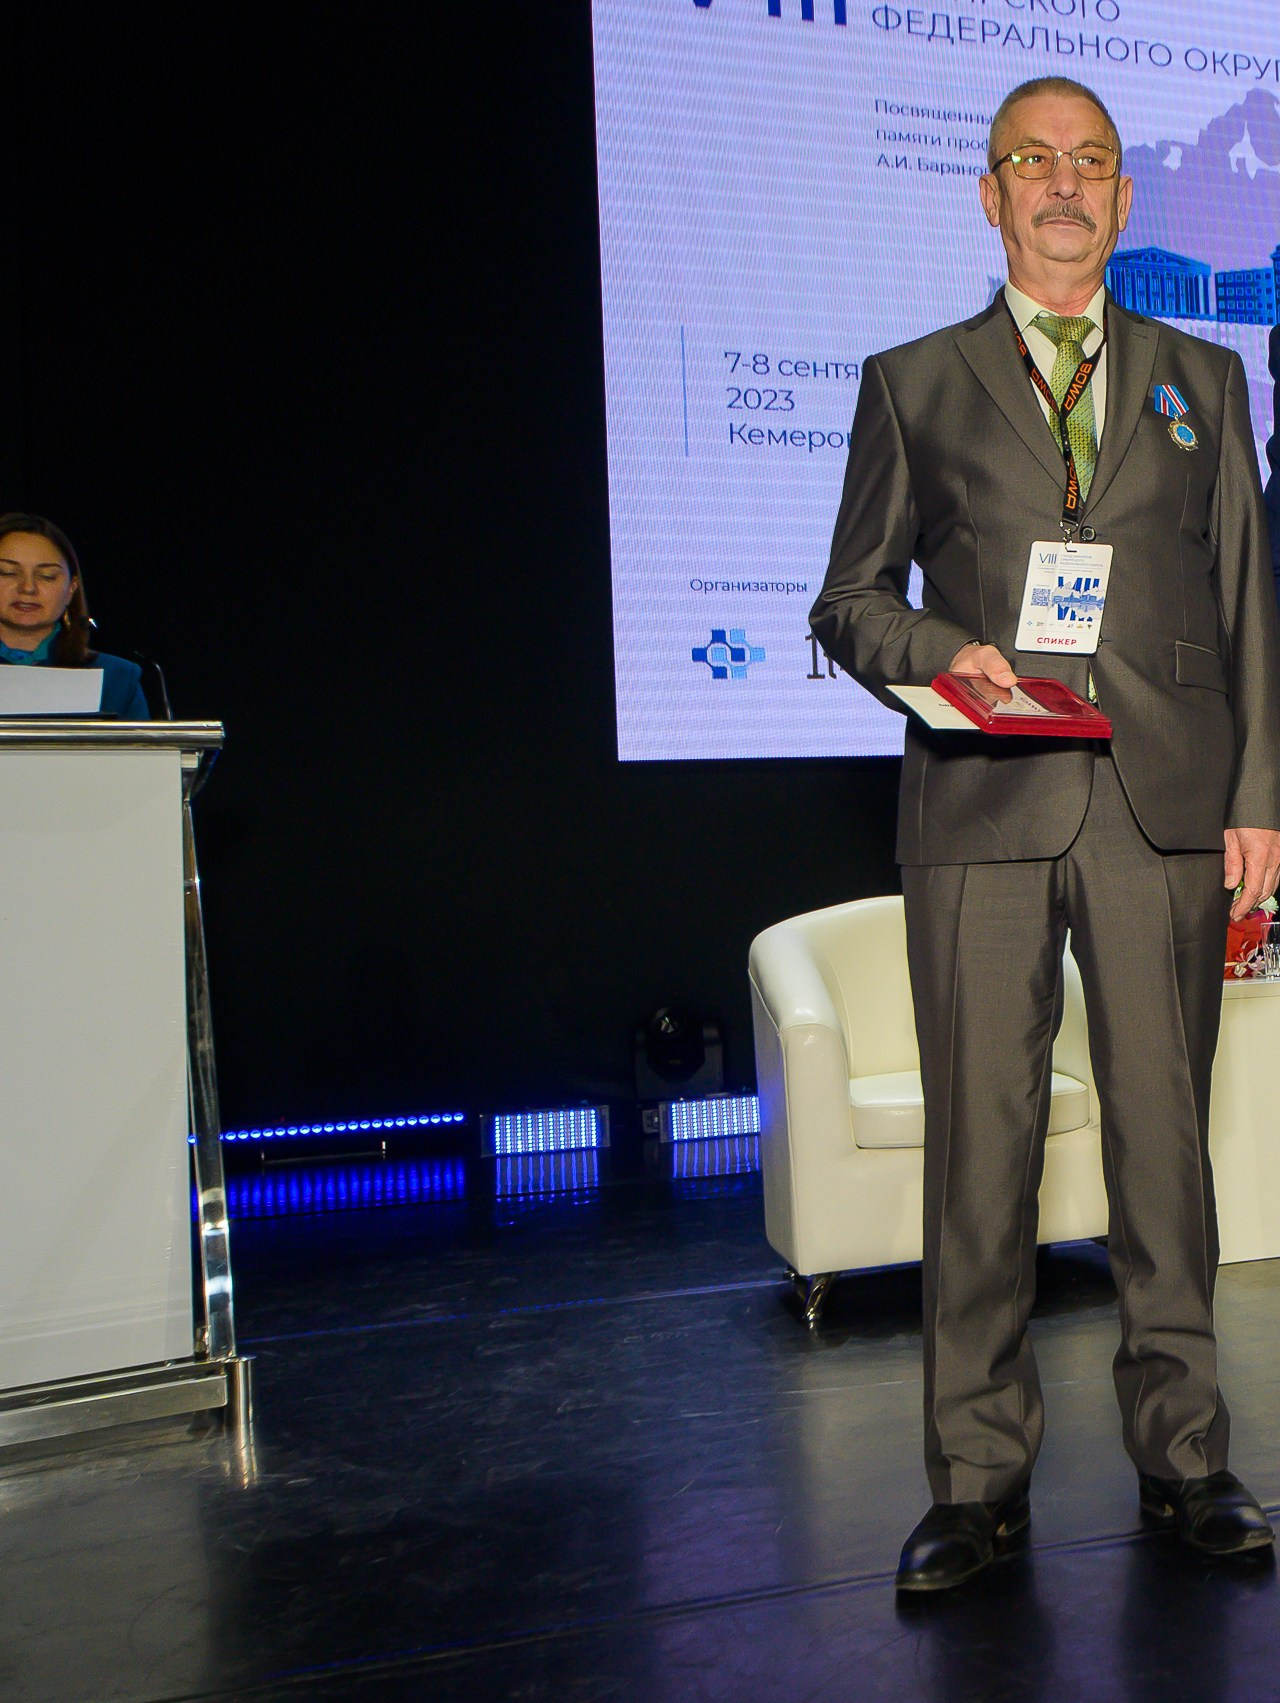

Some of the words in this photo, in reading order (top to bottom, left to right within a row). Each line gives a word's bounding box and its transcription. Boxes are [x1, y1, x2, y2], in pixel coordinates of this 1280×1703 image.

[871, 5, 1172, 67] ФЕДЕРАЛЬНОГО
[874, 99, 993, 125] Посвященны
[876, 130, 941, 146] памяти
[877, 154, 913, 170] А.И.
[724, 352, 770, 375] 7-8
[778, 359, 860, 380] сентя
[726, 387, 795, 412] 2023
[1039, 552, 1057, 564] VIII
[690, 578, 808, 595] Организаторы
[1036, 637, 1077, 646] СПИКЕР
